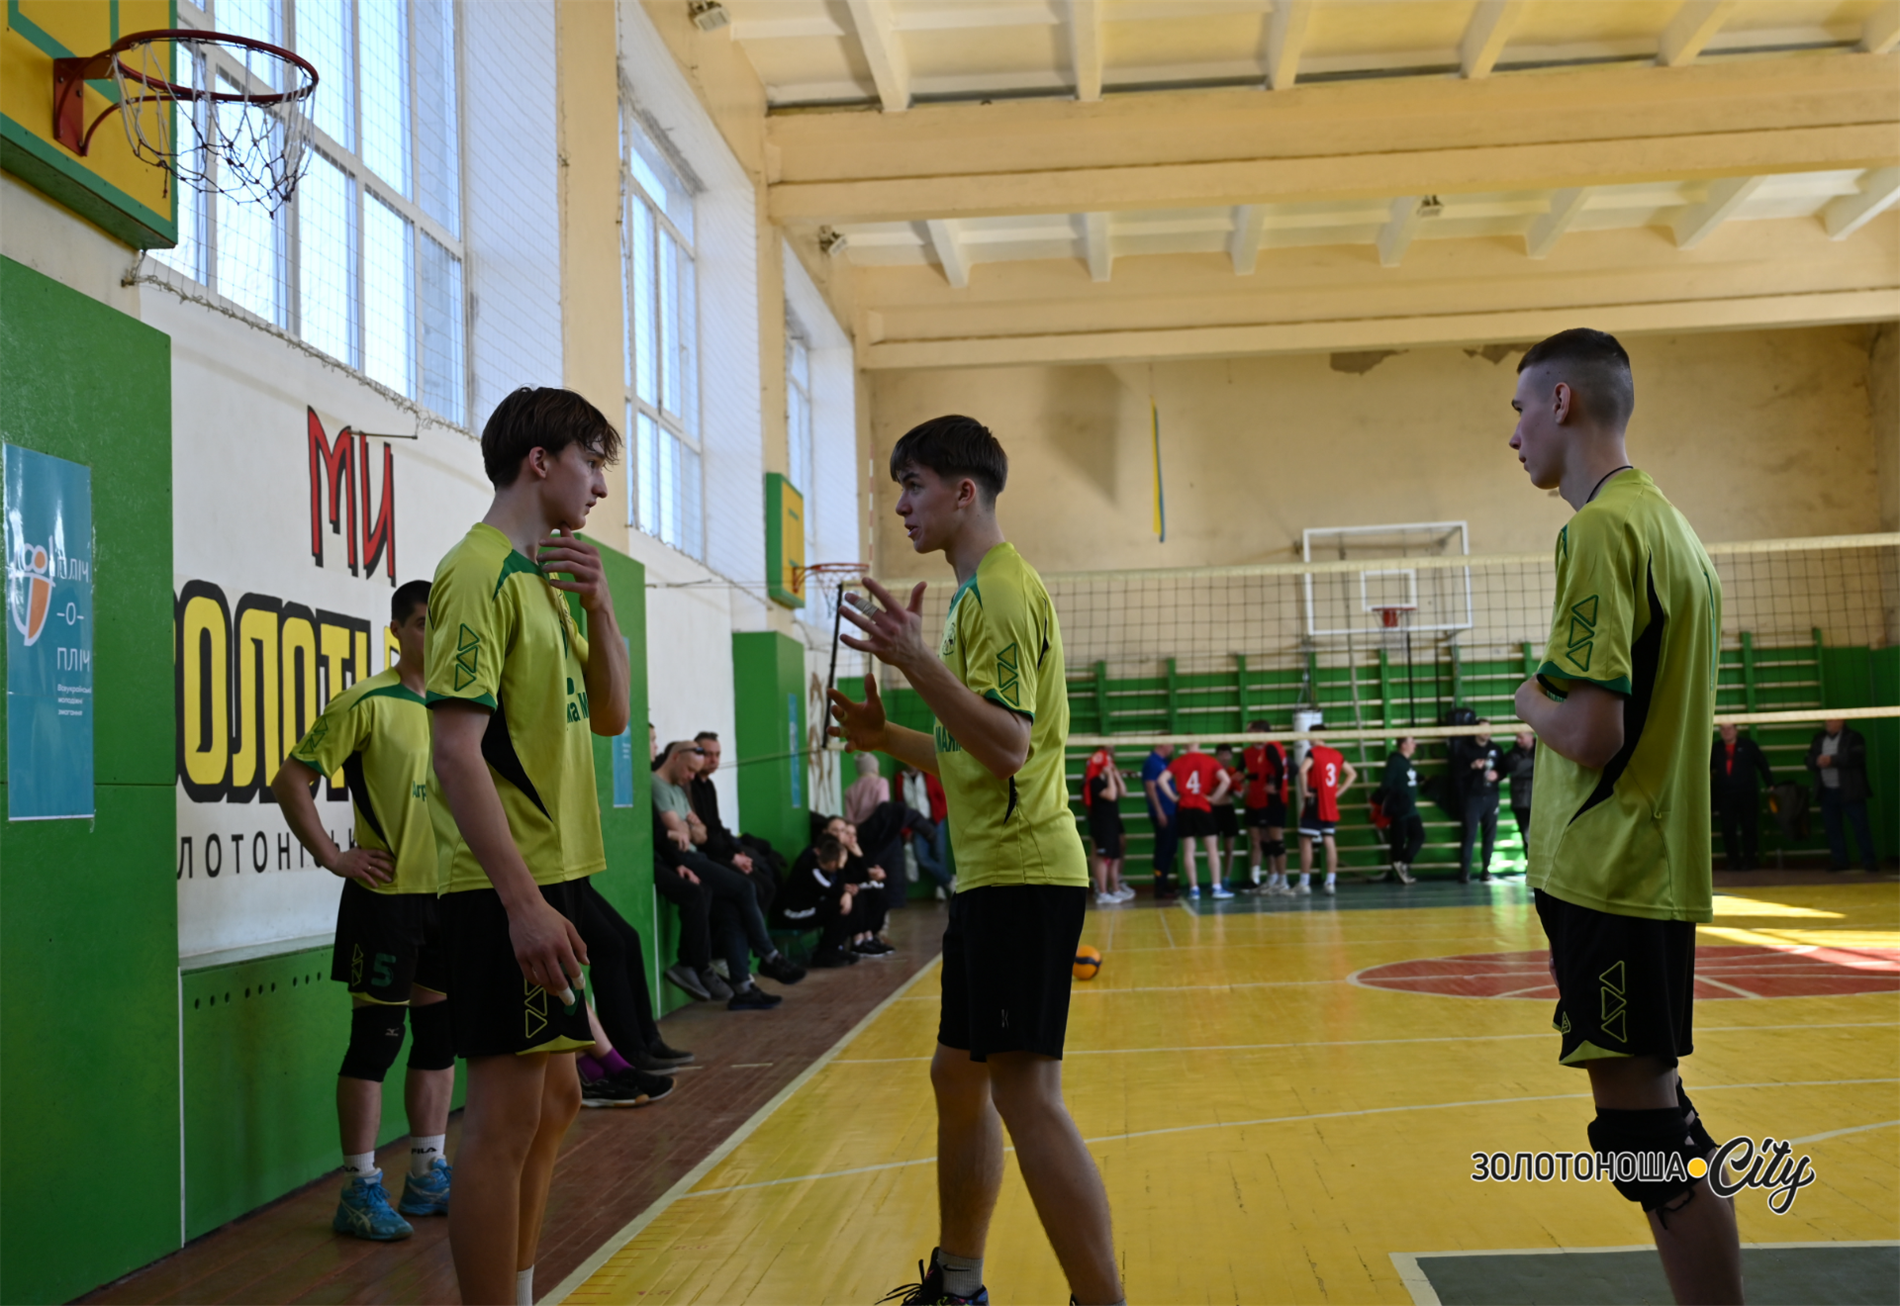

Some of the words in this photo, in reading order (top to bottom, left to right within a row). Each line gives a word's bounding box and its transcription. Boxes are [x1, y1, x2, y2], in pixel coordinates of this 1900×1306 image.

[307, 405, 396, 587] МИ
[57, 647, 90, 672] ПЛІЧ
[1186, 770, 1201, 794] 4
[1325, 763, 1337, 787] 3
[371, 952, 396, 987] 5
